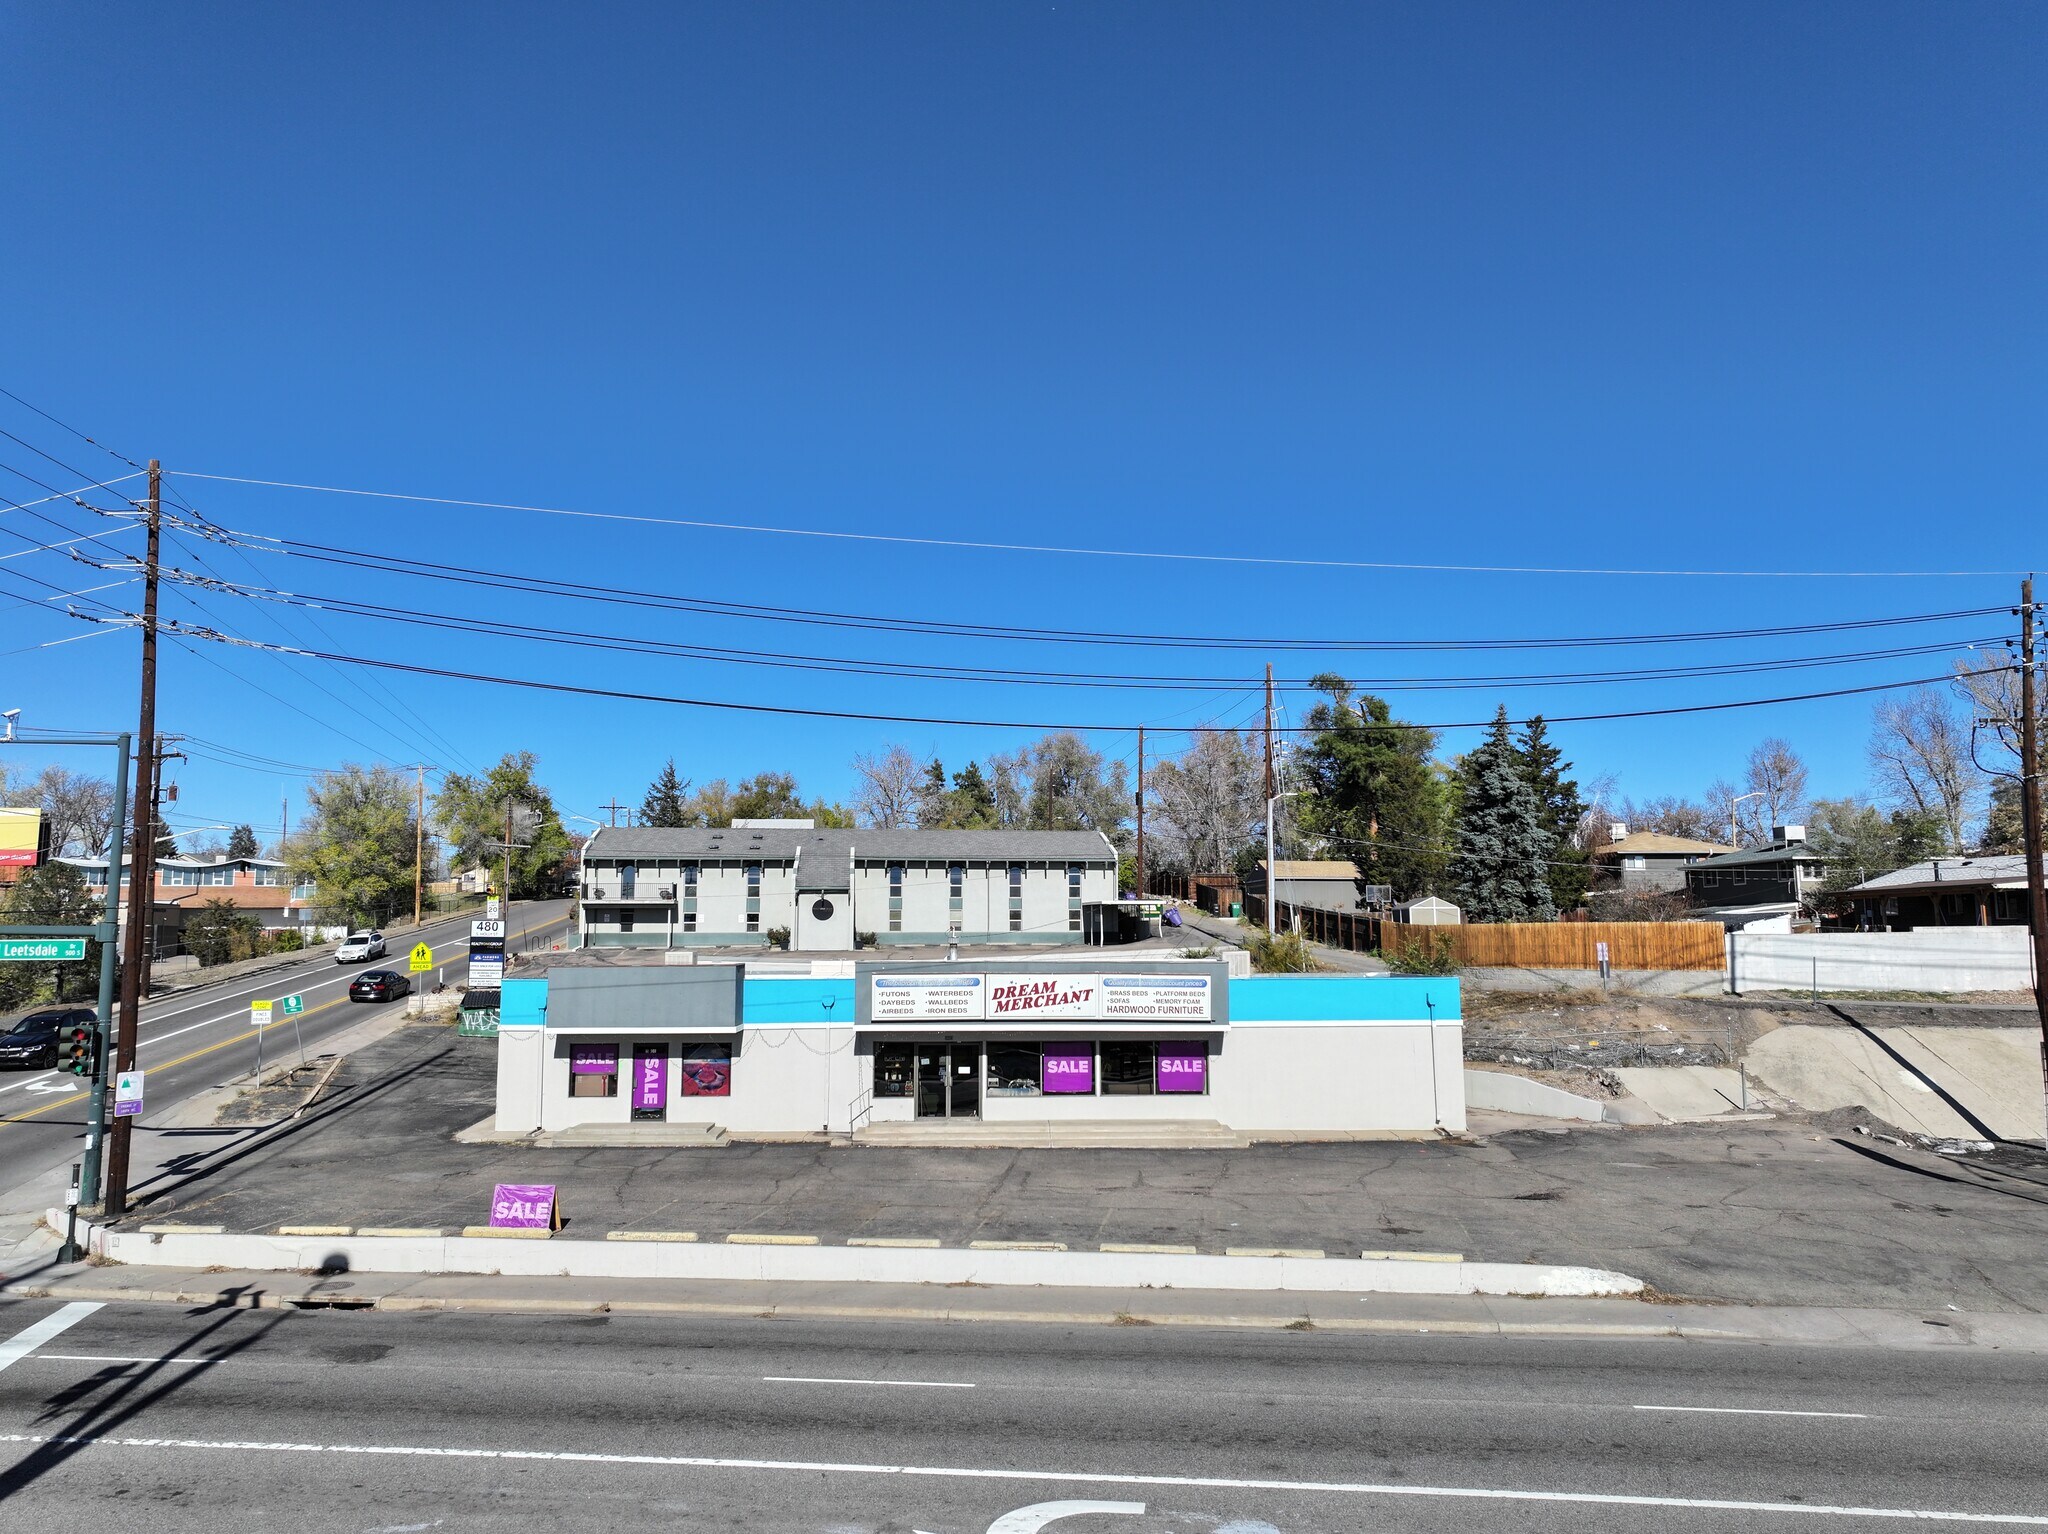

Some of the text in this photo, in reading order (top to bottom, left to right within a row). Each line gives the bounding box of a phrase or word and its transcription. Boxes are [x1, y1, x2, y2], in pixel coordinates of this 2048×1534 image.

[476, 921, 499, 932] 480
[4, 943, 58, 957] Leetsdale
[992, 980, 1057, 1000] DREAM
[994, 989, 1094, 1014] MERCHANT
[1106, 1005, 1204, 1014] HARDWOOD FURNITURE
[576, 1052, 615, 1065] SALE
[1047, 1060, 1089, 1074] SALE
[1161, 1059, 1202, 1073] SALE
[644, 1058, 660, 1105] SALE
[494, 1201, 550, 1219] SALE
